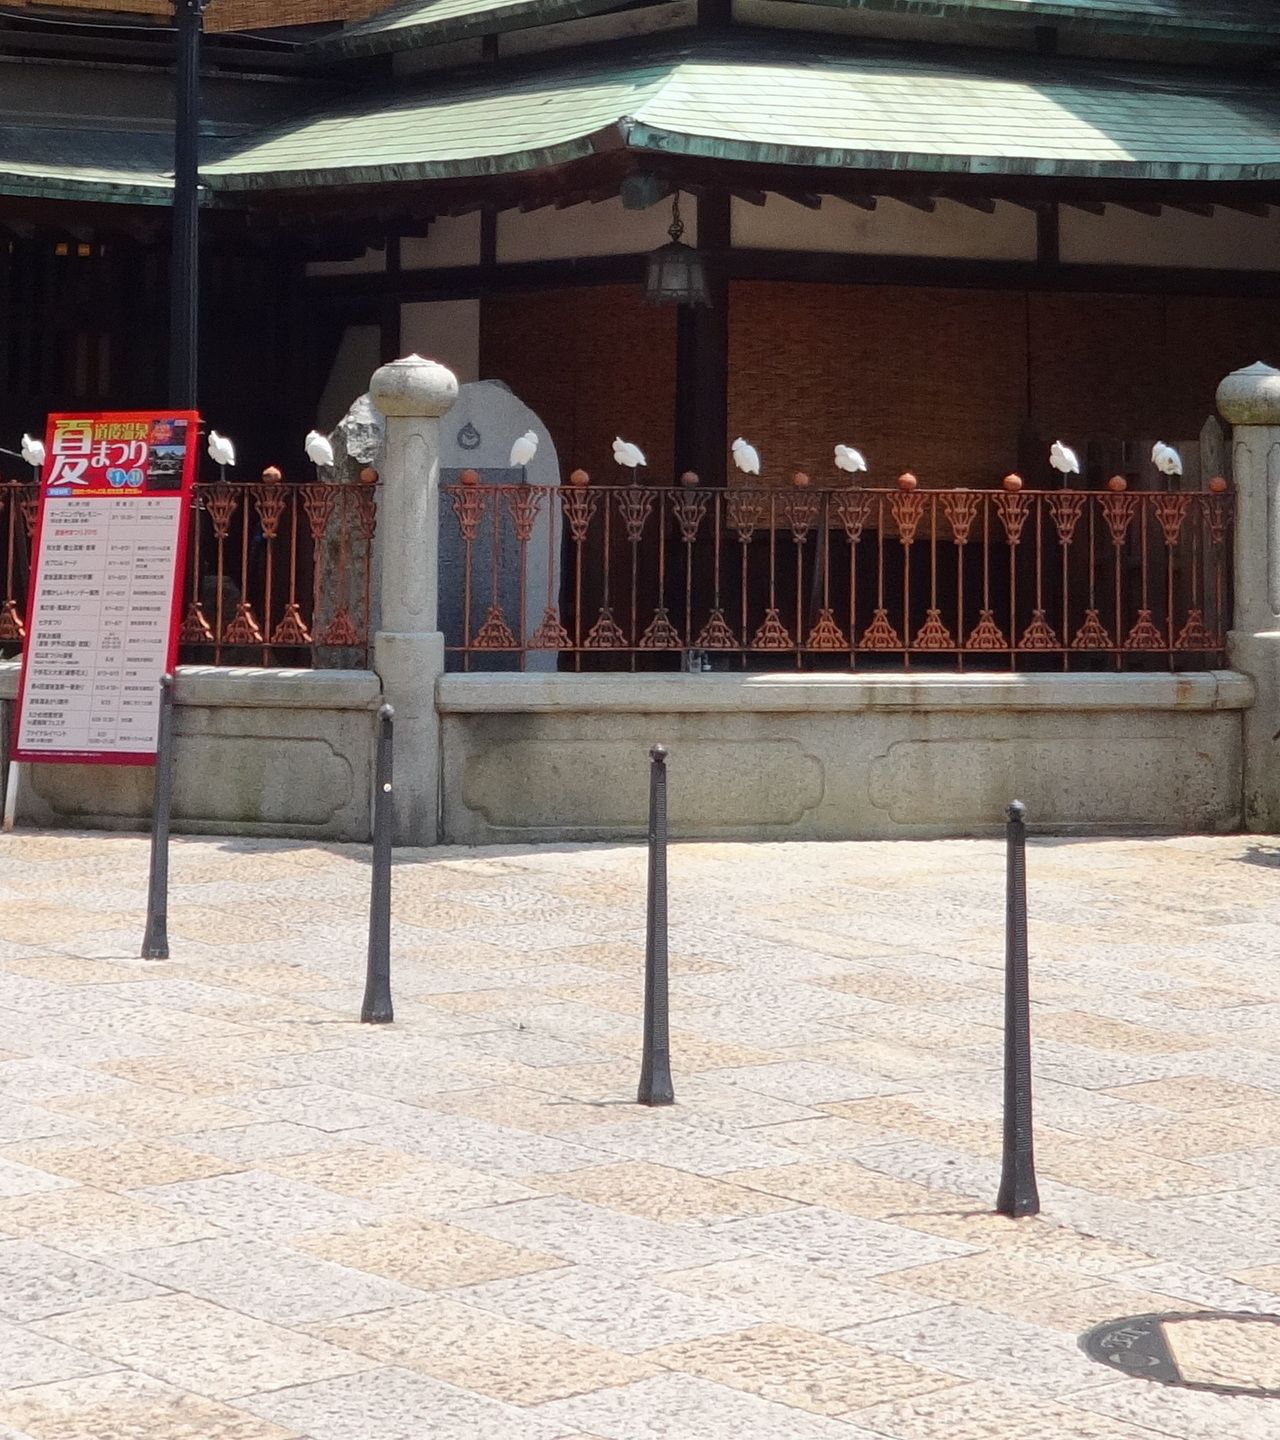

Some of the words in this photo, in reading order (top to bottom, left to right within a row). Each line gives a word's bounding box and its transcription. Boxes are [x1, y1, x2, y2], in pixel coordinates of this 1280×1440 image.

[94, 423, 148, 440] 道後温泉
[47, 419, 94, 485] 夏
[91, 440, 148, 467] まつり
